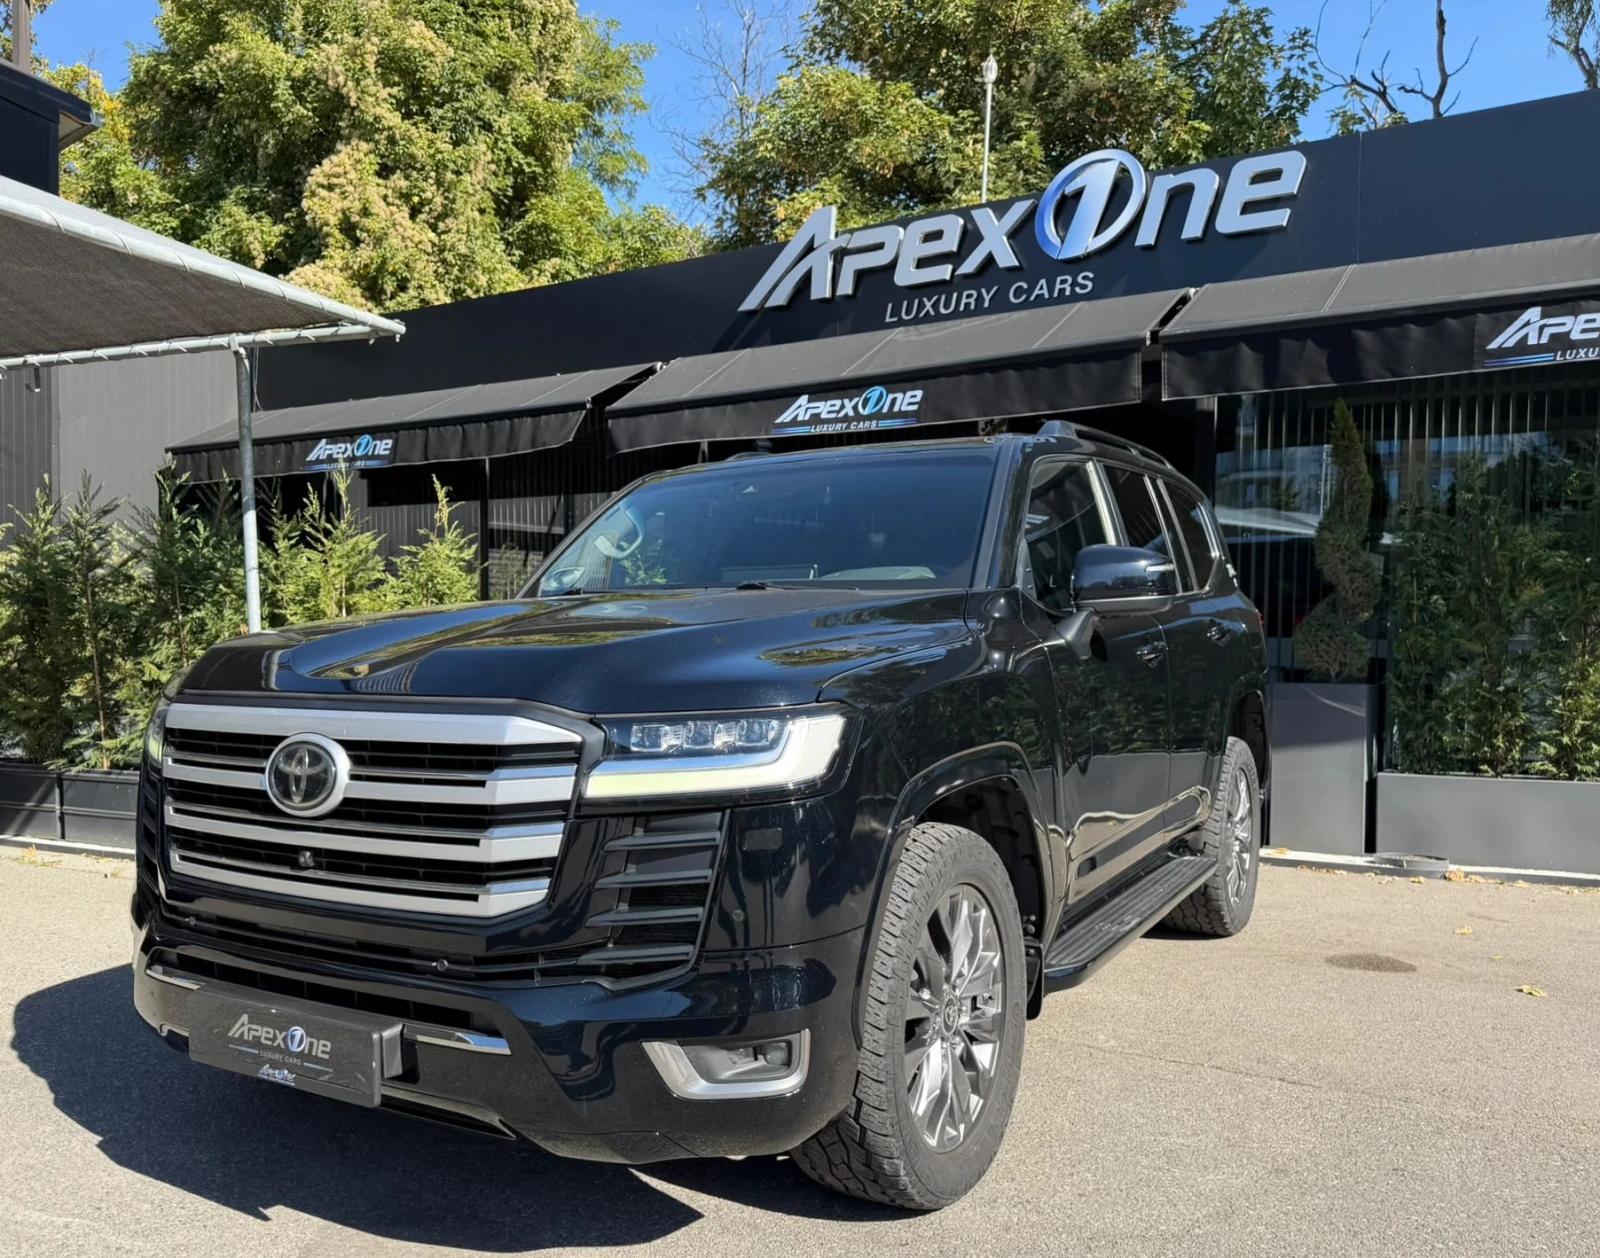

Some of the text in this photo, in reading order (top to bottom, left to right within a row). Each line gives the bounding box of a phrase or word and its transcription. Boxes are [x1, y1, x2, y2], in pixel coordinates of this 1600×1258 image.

[885, 271, 1094, 323] LUXURY CARS
[810, 420, 877, 433] LUXURY CARS
[260, 1050, 301, 1065] LUXURY CARS
